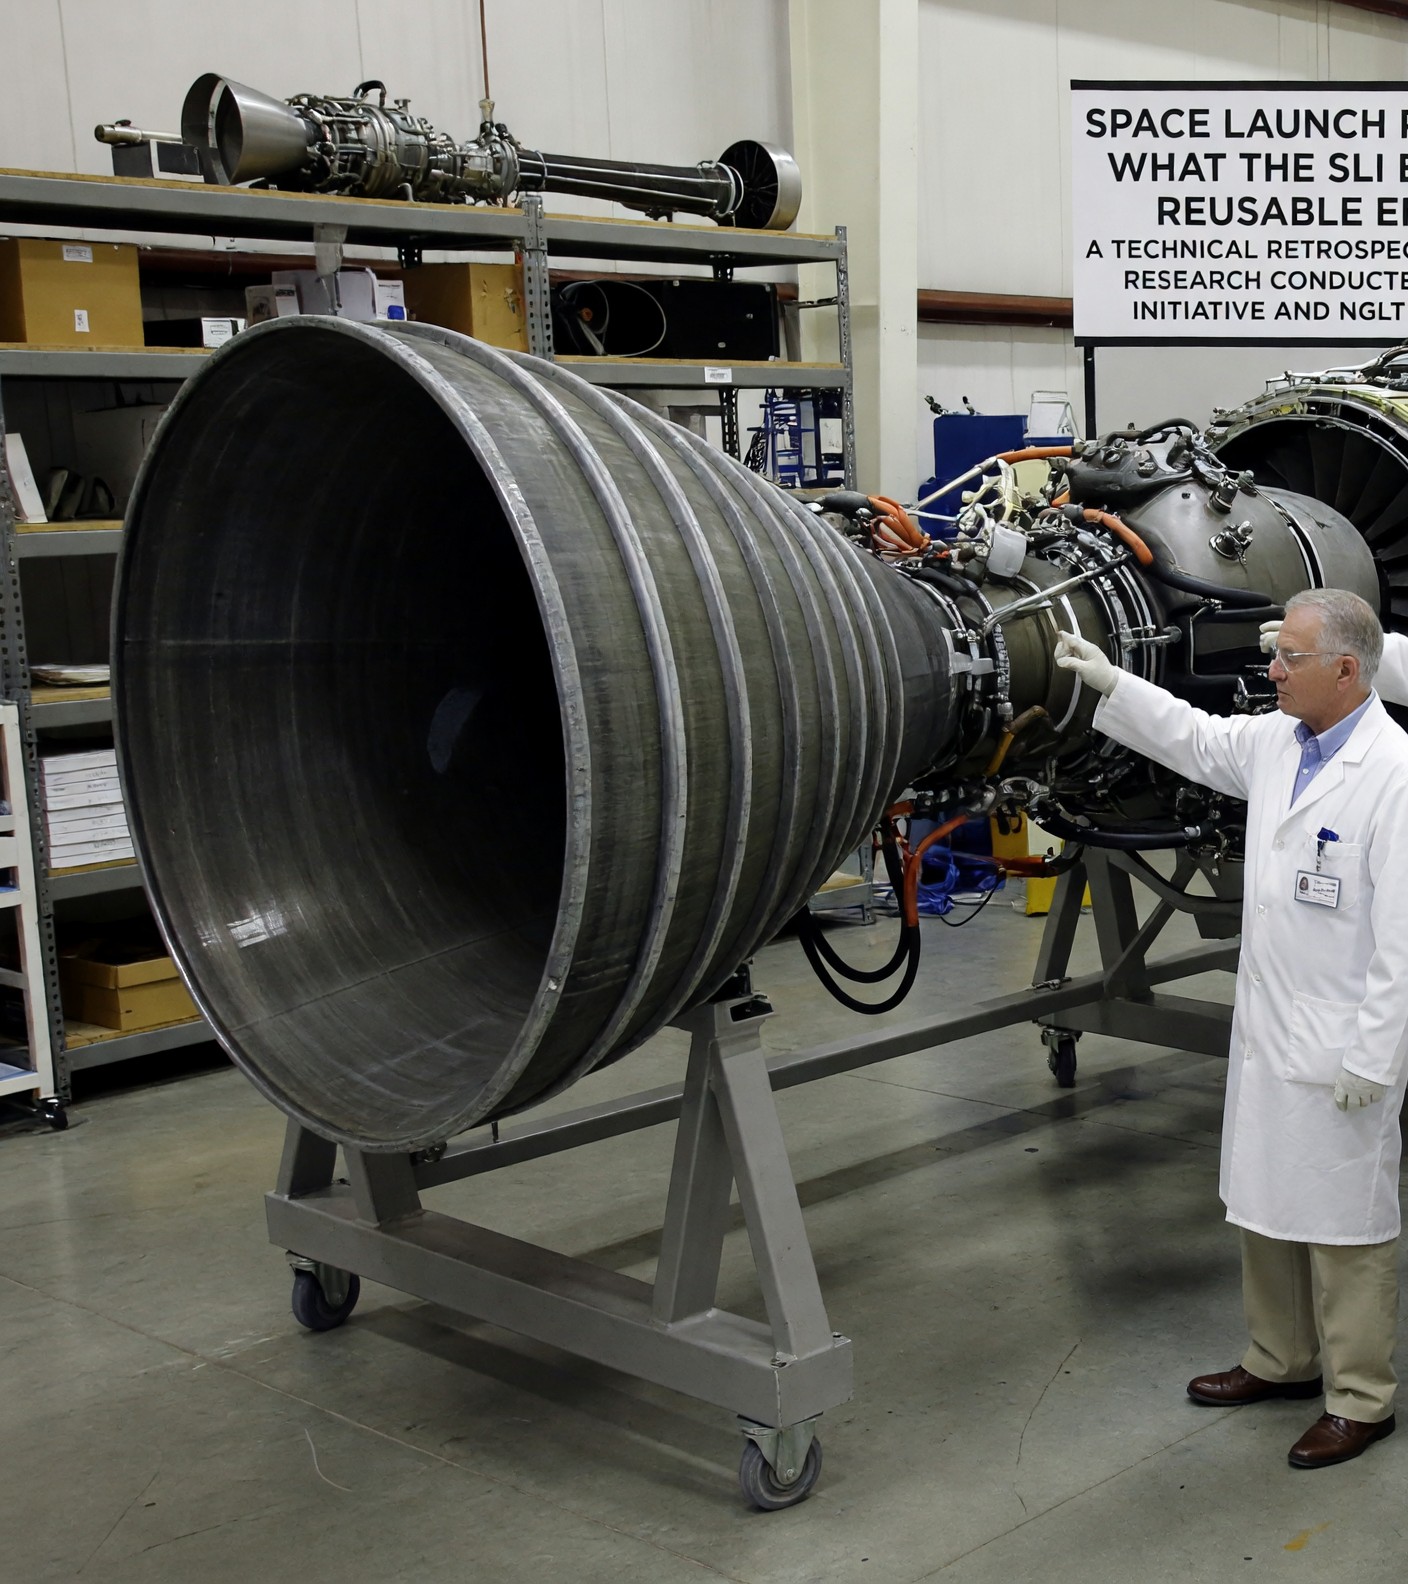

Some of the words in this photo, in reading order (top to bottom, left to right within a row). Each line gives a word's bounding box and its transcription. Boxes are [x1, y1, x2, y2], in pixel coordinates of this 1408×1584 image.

[1085, 108, 1211, 139] SPACE
[1224, 108, 1386, 139] LAUNCH
[1107, 152, 1227, 182] WHAT
[1238, 152, 1315, 183] THE
[1328, 152, 1384, 183] SLI
[1157, 196, 1363, 227] REUSABLE
[1085, 239, 1104, 259] A
[1111, 239, 1259, 260] TECHNICAL
[1124, 270, 1261, 290] RESEARCH
[1133, 300, 1266, 321] INITIATIVE
[1273, 301, 1330, 321] AND
[1339, 301, 1406, 321] NGLT
